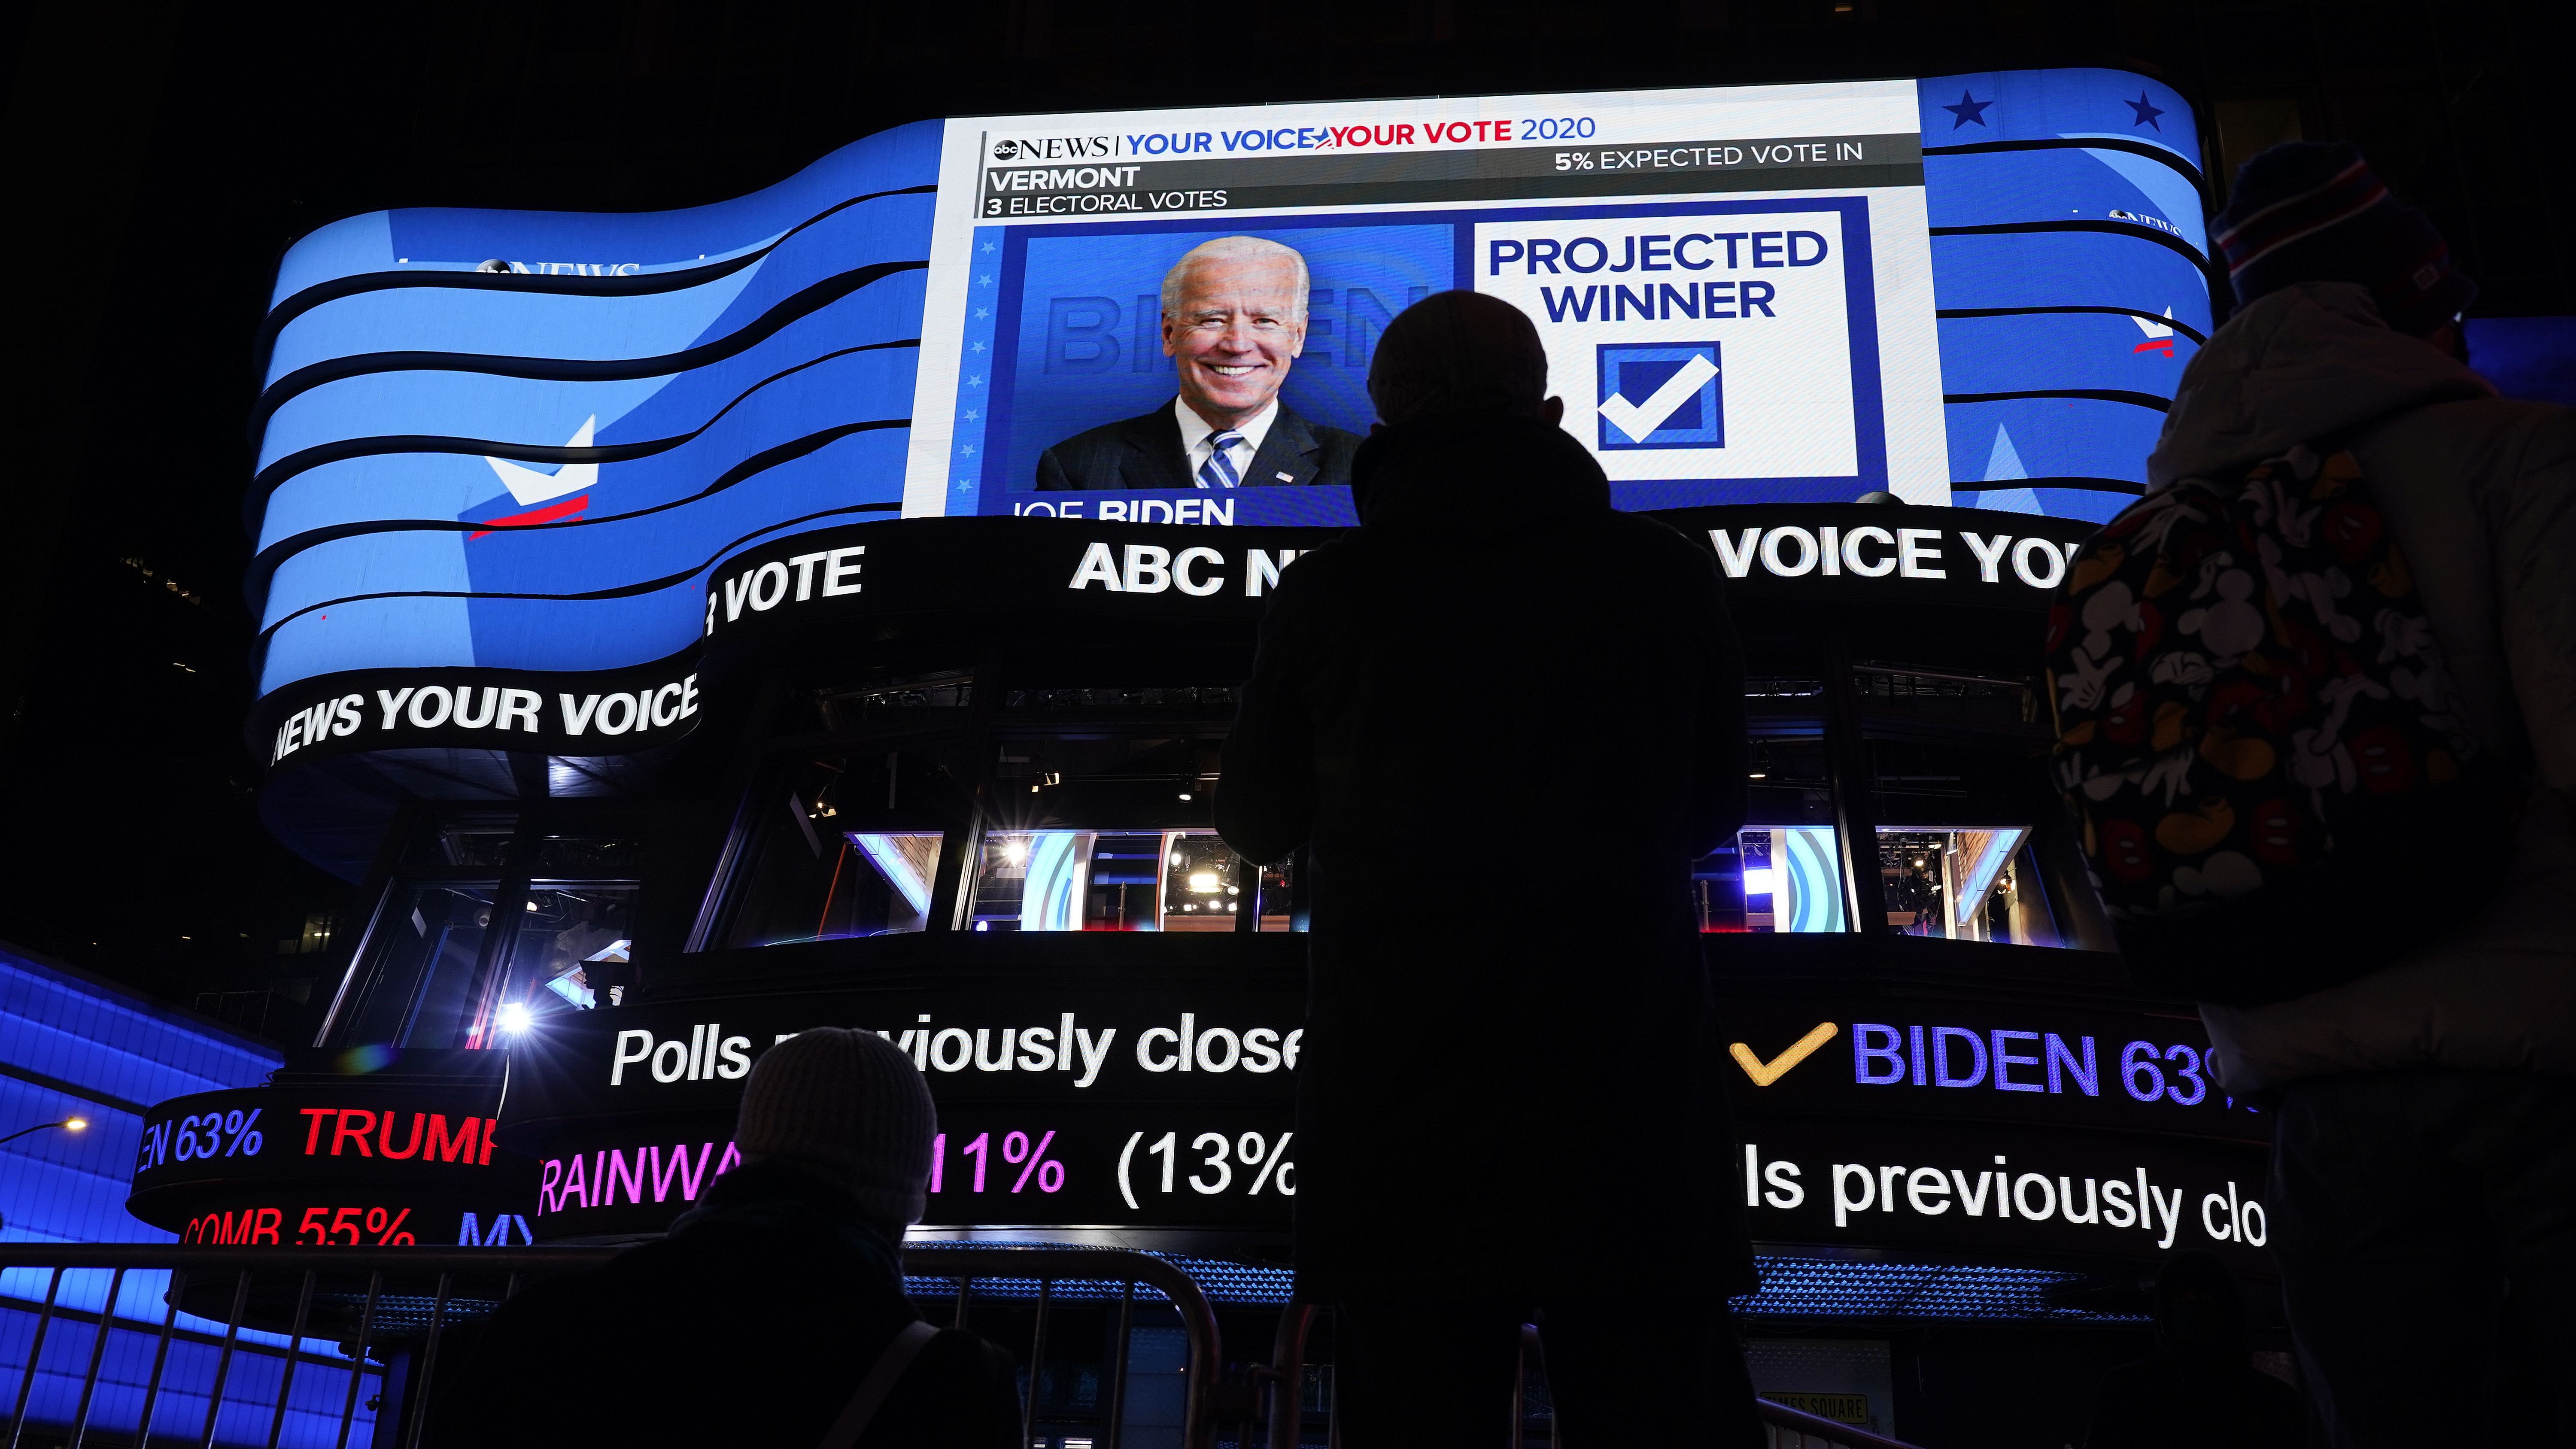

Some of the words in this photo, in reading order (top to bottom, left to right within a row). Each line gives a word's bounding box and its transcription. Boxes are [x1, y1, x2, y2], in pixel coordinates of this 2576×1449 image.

[1017, 135, 1109, 160] NEWS
[1127, 131, 1212, 155] YOUR
[1221, 127, 1315, 152] VOICE
[1330, 123, 1415, 147] YOUR
[1423, 120, 1512, 144] VOTE
[1521, 117, 1595, 140] 2020
[1554, 152, 1594, 170] 5%
[1601, 147, 1743, 170] EXPECTED
[1751, 143, 1827, 164] VOTE
[1836, 142, 1863, 161] IN
[987, 198, 1002, 215] 3
[1010, 193, 1143, 214] ELECTORAL
[1148, 189, 1227, 210] VOTES
[990, 166, 1140, 191] VERMONT
[1489, 229, 1829, 276] PROJECTED
[1540, 279, 1776, 323] WINNER
[1043, 286, 1429, 376] BIN
[1099, 498, 1235, 526] BIDEN
[725, 545, 865, 623] VOTE
[1068, 541, 1224, 597] ABC
[1245, 549, 1317, 597] N
[1708, 526, 1947, 578] VOICE
[1960, 532, 2081, 589] YO
[271, 693, 362, 767] NEWS
[377, 685, 542, 733] YOUR
[560, 673, 699, 736] VOICE
[611, 1023, 751, 1087] Polls
[1853, 1023, 2099, 1096] BIDEN
[2121, 1040, 2259, 1113] 63
[175, 1108, 263, 1161] 63%
[1117, 1130, 1296, 1210] (13%
[295, 1207, 416, 1248] 55%
[1832, 1155, 2183, 1249] previously
[2201, 1181, 2267, 1248] clo
[1811, 1398, 1863, 1419] SQUARE
